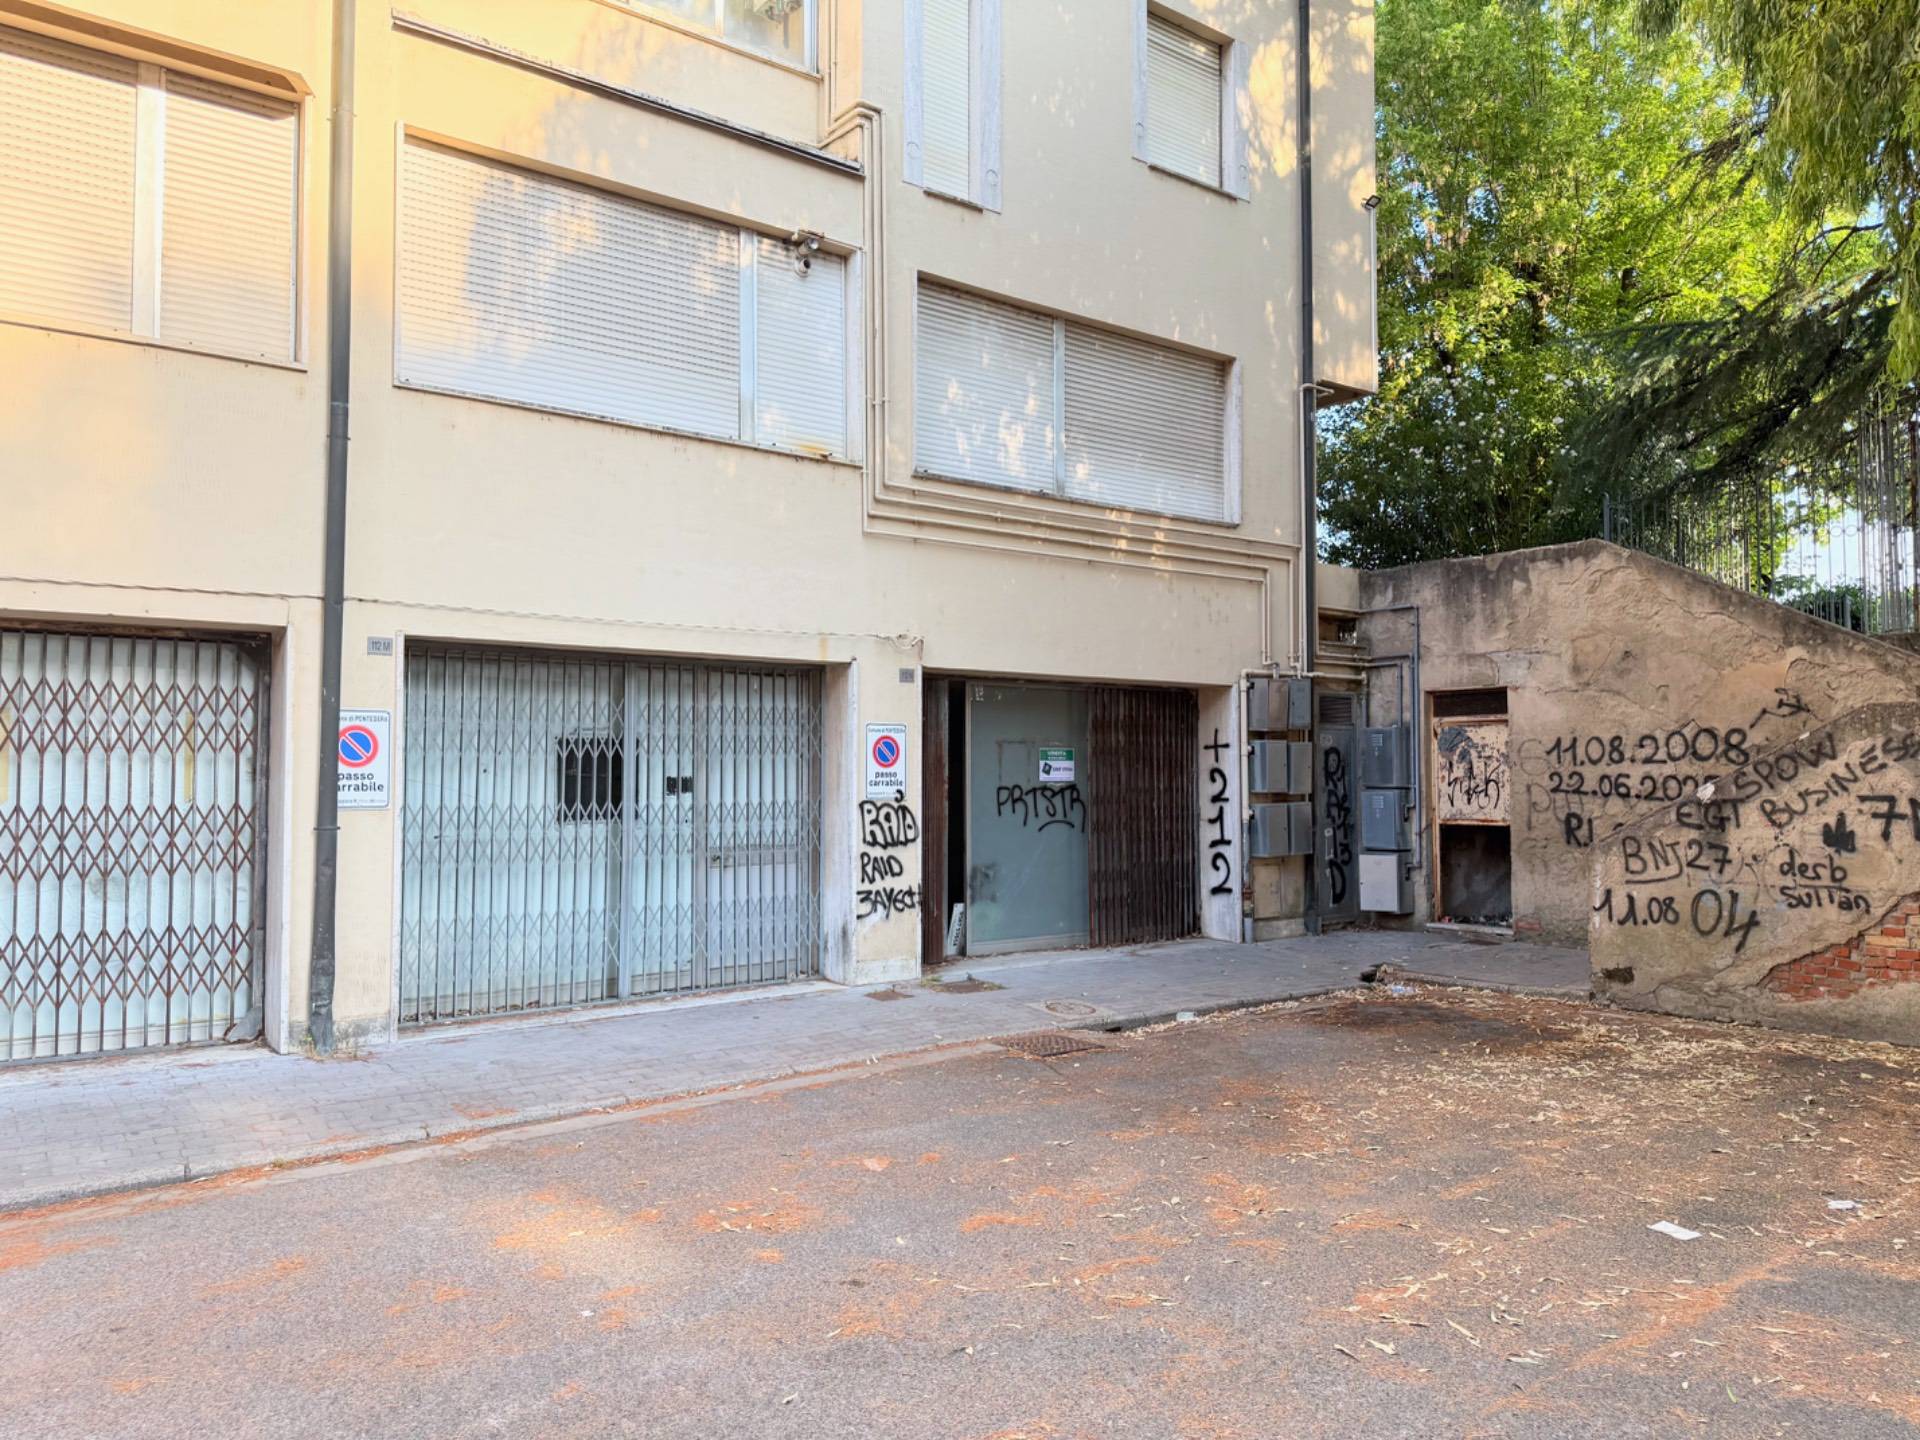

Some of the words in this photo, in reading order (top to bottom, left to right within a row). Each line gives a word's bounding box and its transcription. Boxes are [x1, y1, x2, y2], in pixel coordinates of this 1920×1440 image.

[1545, 727, 1751, 767] 11.08.2008
[869, 779, 903, 787] carrabile
[860, 852, 904, 884] RAID
